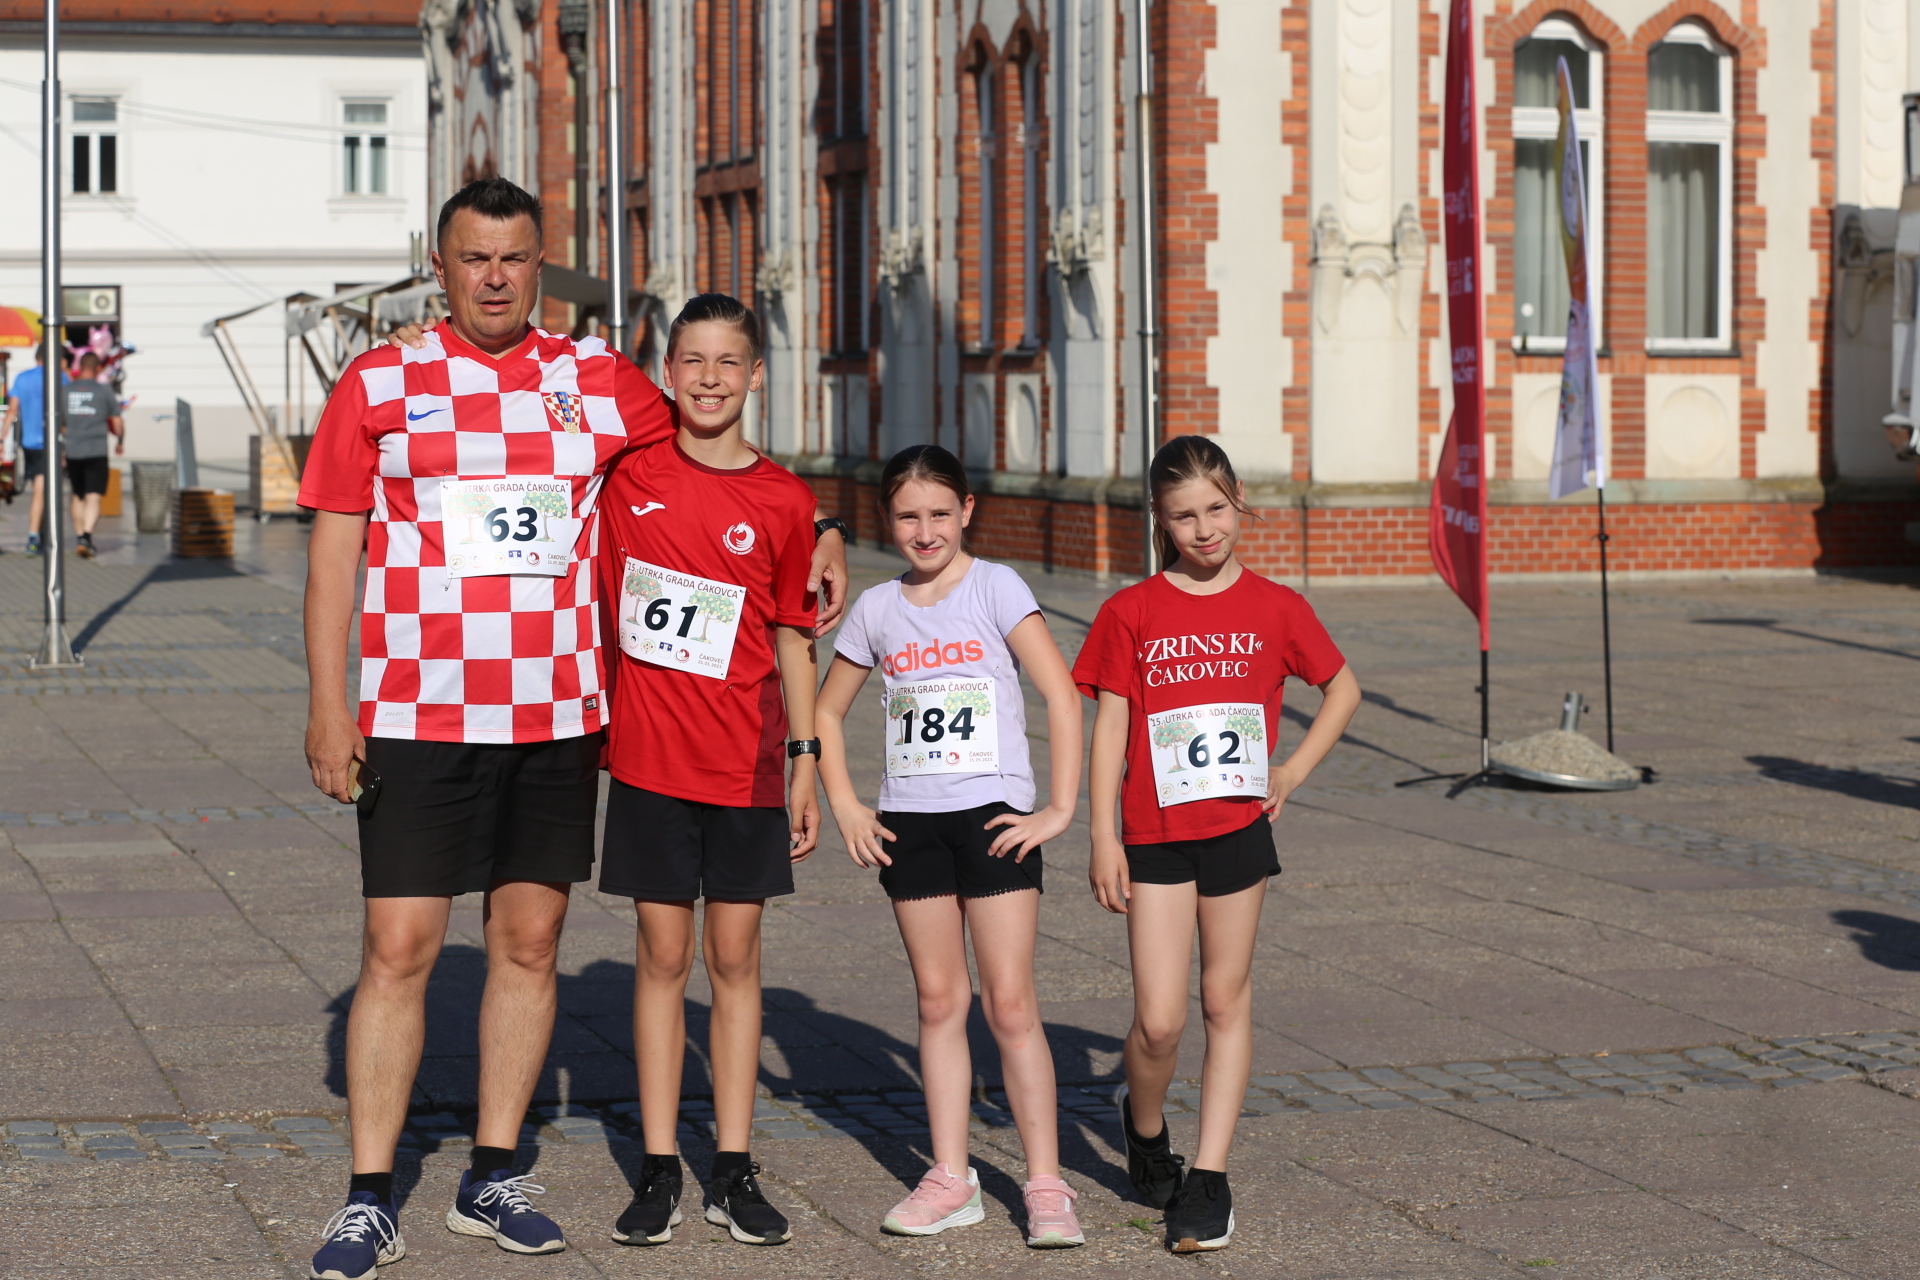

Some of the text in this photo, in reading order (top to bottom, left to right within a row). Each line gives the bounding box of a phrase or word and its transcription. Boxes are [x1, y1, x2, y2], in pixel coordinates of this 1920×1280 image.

[493, 483, 525, 492] GRADA
[526, 481, 566, 493] ČAKOVCA
[483, 506, 538, 543] 63
[627, 562, 738, 599] 15. UTRKA GRADA ČAKOVCA
[644, 598, 699, 638] 61
[699, 653, 724, 664] ČAKOVEC
[883, 638, 984, 676] adidas
[1146, 660, 1249, 687] ČAKOVEC
[896, 686, 916, 697] UTRKA
[917, 683, 946, 694] GRADA
[948, 681, 989, 692] ČAKOVCA
[902, 706, 976, 744] 184
[1151, 705, 1261, 728] 15. UTRKA GADA ČAKOVCA
[1187, 730, 1241, 768] 62
